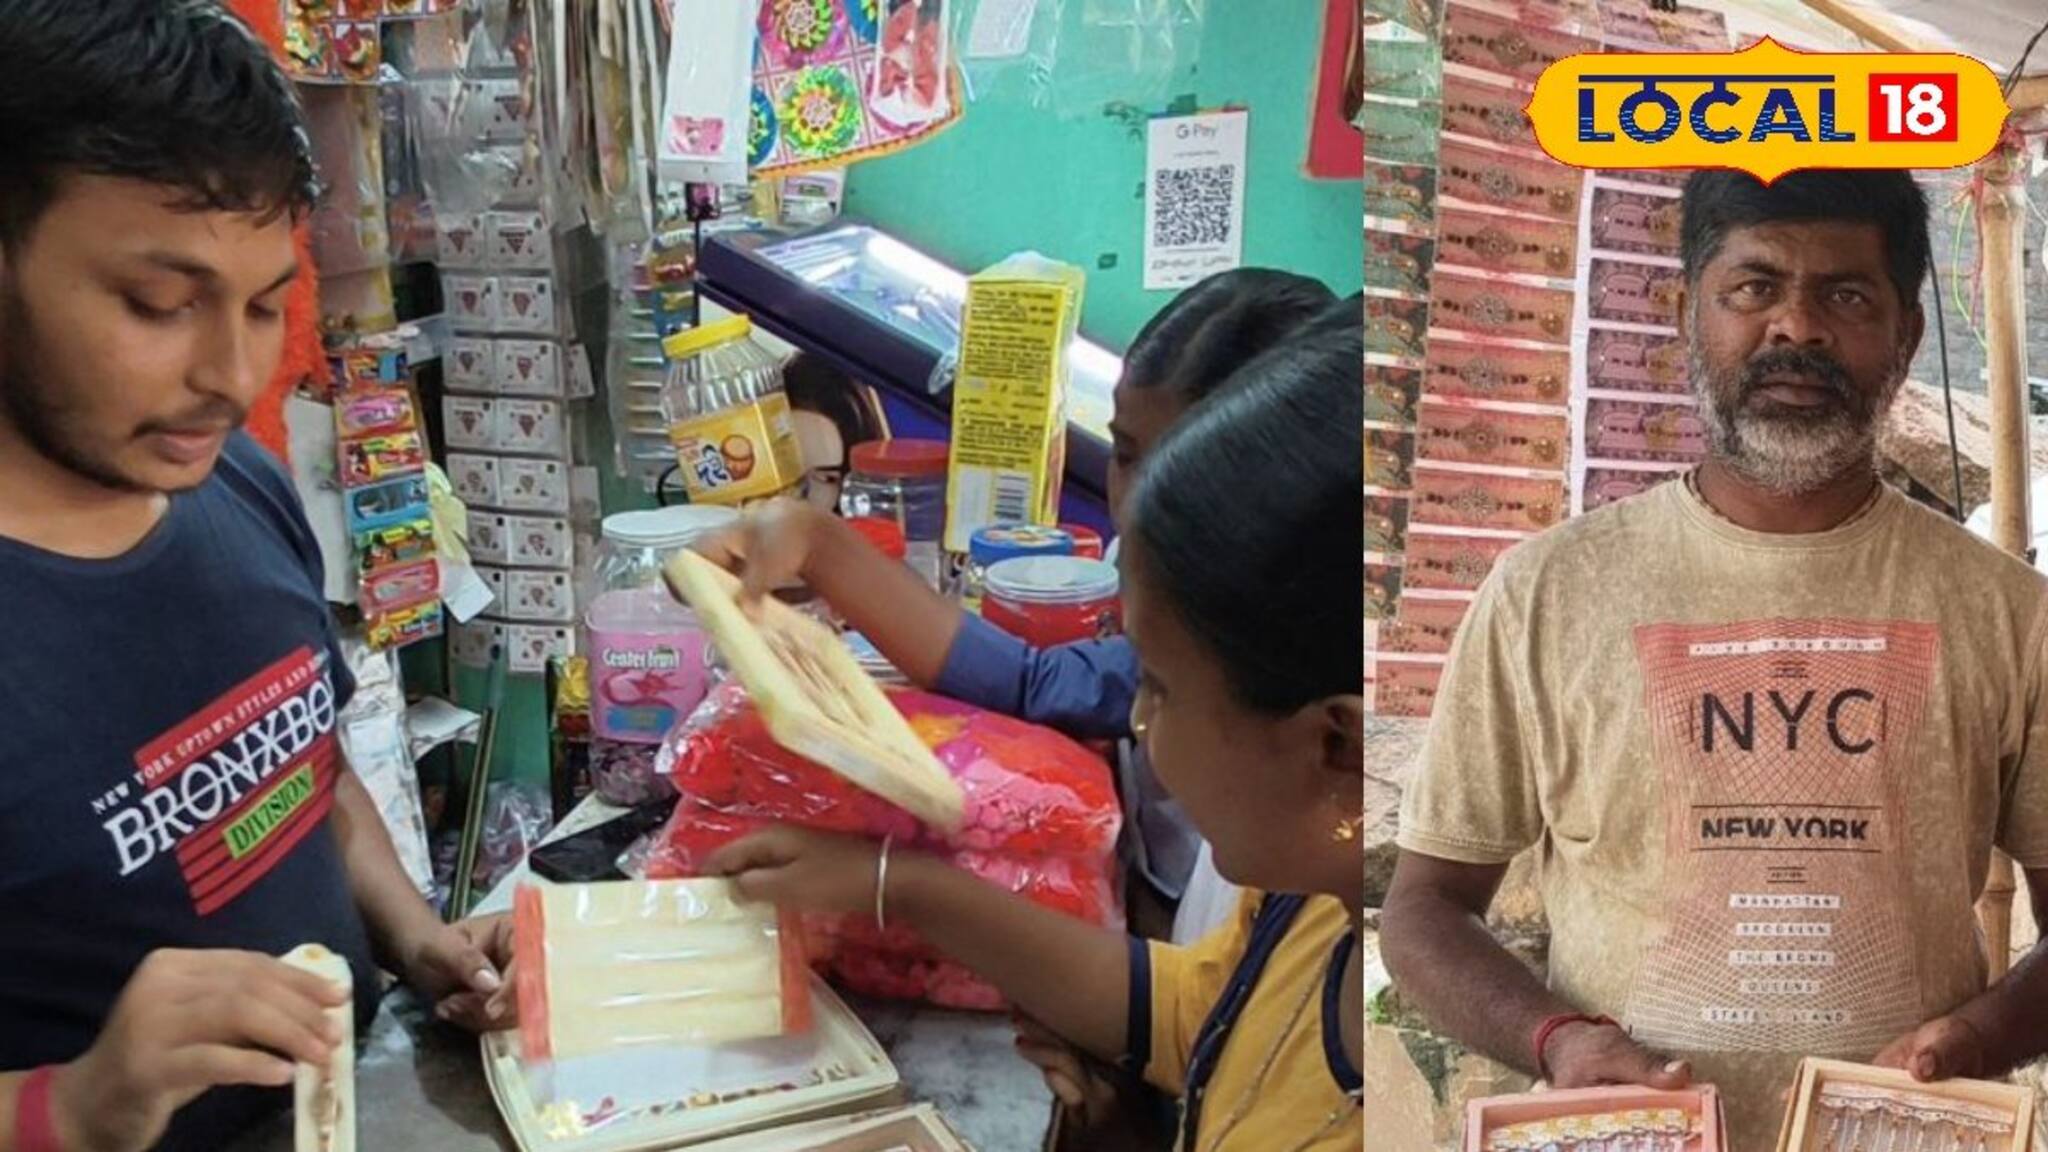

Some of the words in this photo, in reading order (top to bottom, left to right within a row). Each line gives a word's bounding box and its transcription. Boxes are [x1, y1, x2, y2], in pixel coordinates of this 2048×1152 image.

[1703, 688, 1875, 754] NYC
[91, 782, 129, 814] NEW
[133, 752, 175, 785] YORK
[229, 774, 314, 852] DIVISION
[1702, 817, 1775, 840] NEW
[1783, 817, 1869, 840] YORK
[1748, 982, 1813, 993] QUEENS
